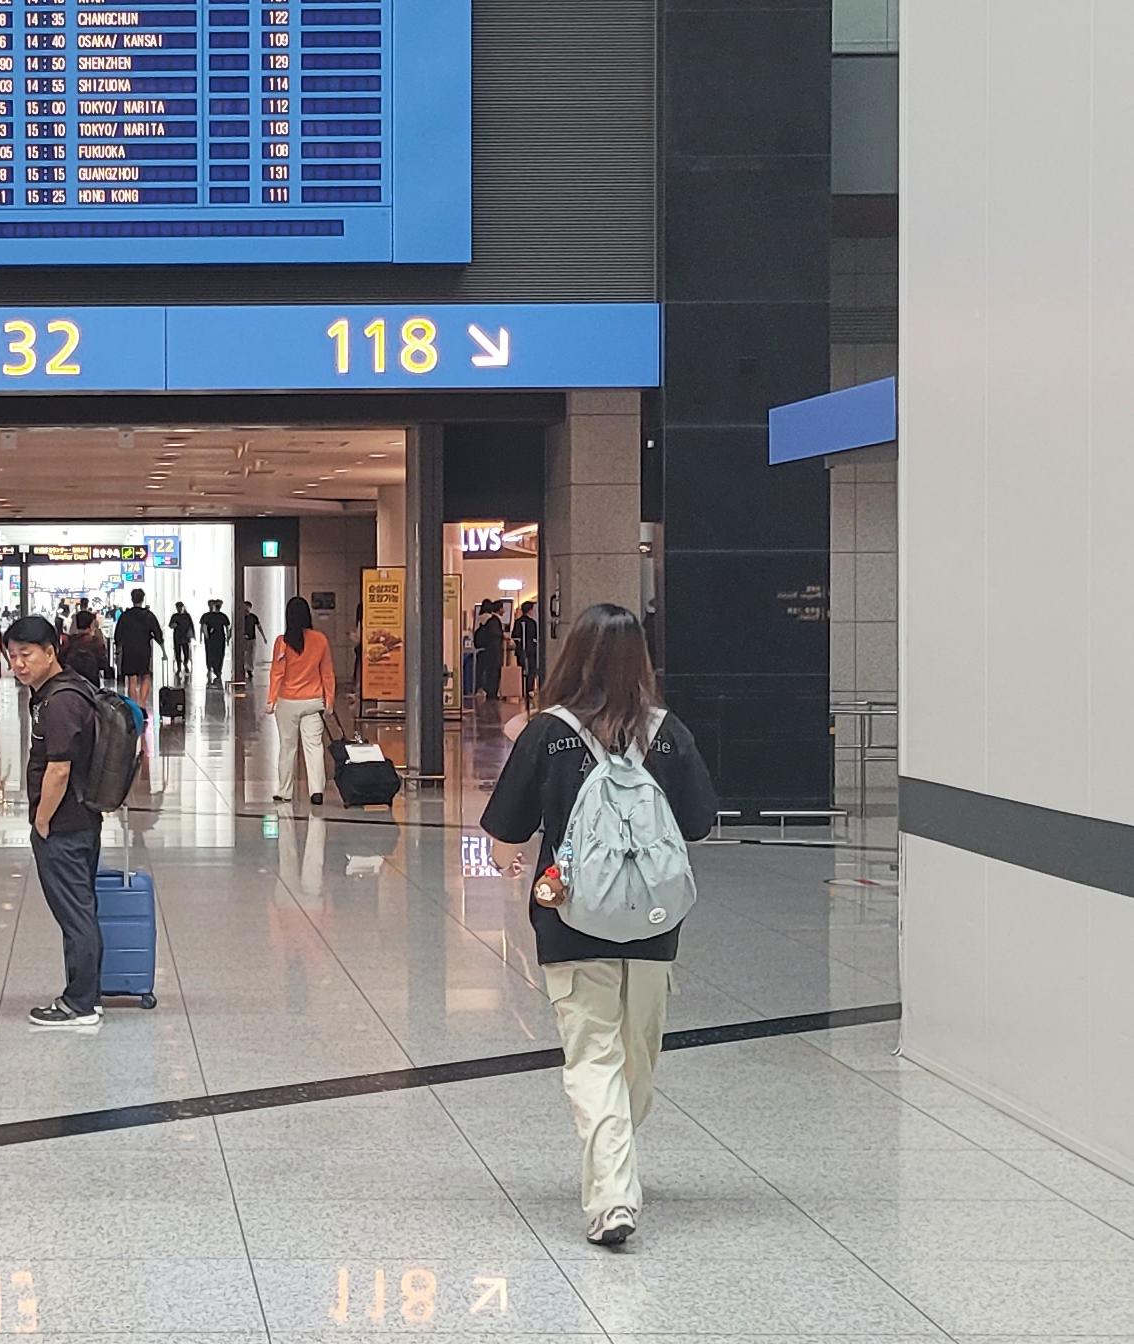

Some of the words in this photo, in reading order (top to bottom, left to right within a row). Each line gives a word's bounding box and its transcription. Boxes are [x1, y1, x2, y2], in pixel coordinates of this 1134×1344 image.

[77, 12, 139, 26] CHANGCHUN
[269, 10, 289, 25] 122
[77, 34, 118, 49] OSAKA/
[123, 34, 163, 48] KANSAI
[269, 33, 289, 47] 109
[78, 56, 132, 70] SHENZHEN
[269, 55, 289, 69] 129
[78, 78, 131, 92] SHIZUOKA
[269, 77, 289, 91] 114
[79, 100, 118, 115] TOKYO/
[123, 100, 165, 114] NARITA
[269, 99, 289, 113] 112
[79, 122, 118, 137] TOKYO/
[123, 122, 165, 136] NARITA
[269, 121, 289, 135] 103
[78, 145, 126, 159] FUKUOKA
[269, 143, 289, 157] 108
[78, 167, 139, 181] GUANGZHOU
[269, 166, 288, 180] 131
[78, 189, 106, 203] HONG
[111, 189, 139, 203] KONG
[269, 188, 288, 202] 111
[326, 316, 440, 376] 118
[147, 538, 176, 554] 122
[547, 735, 583, 755] acm
